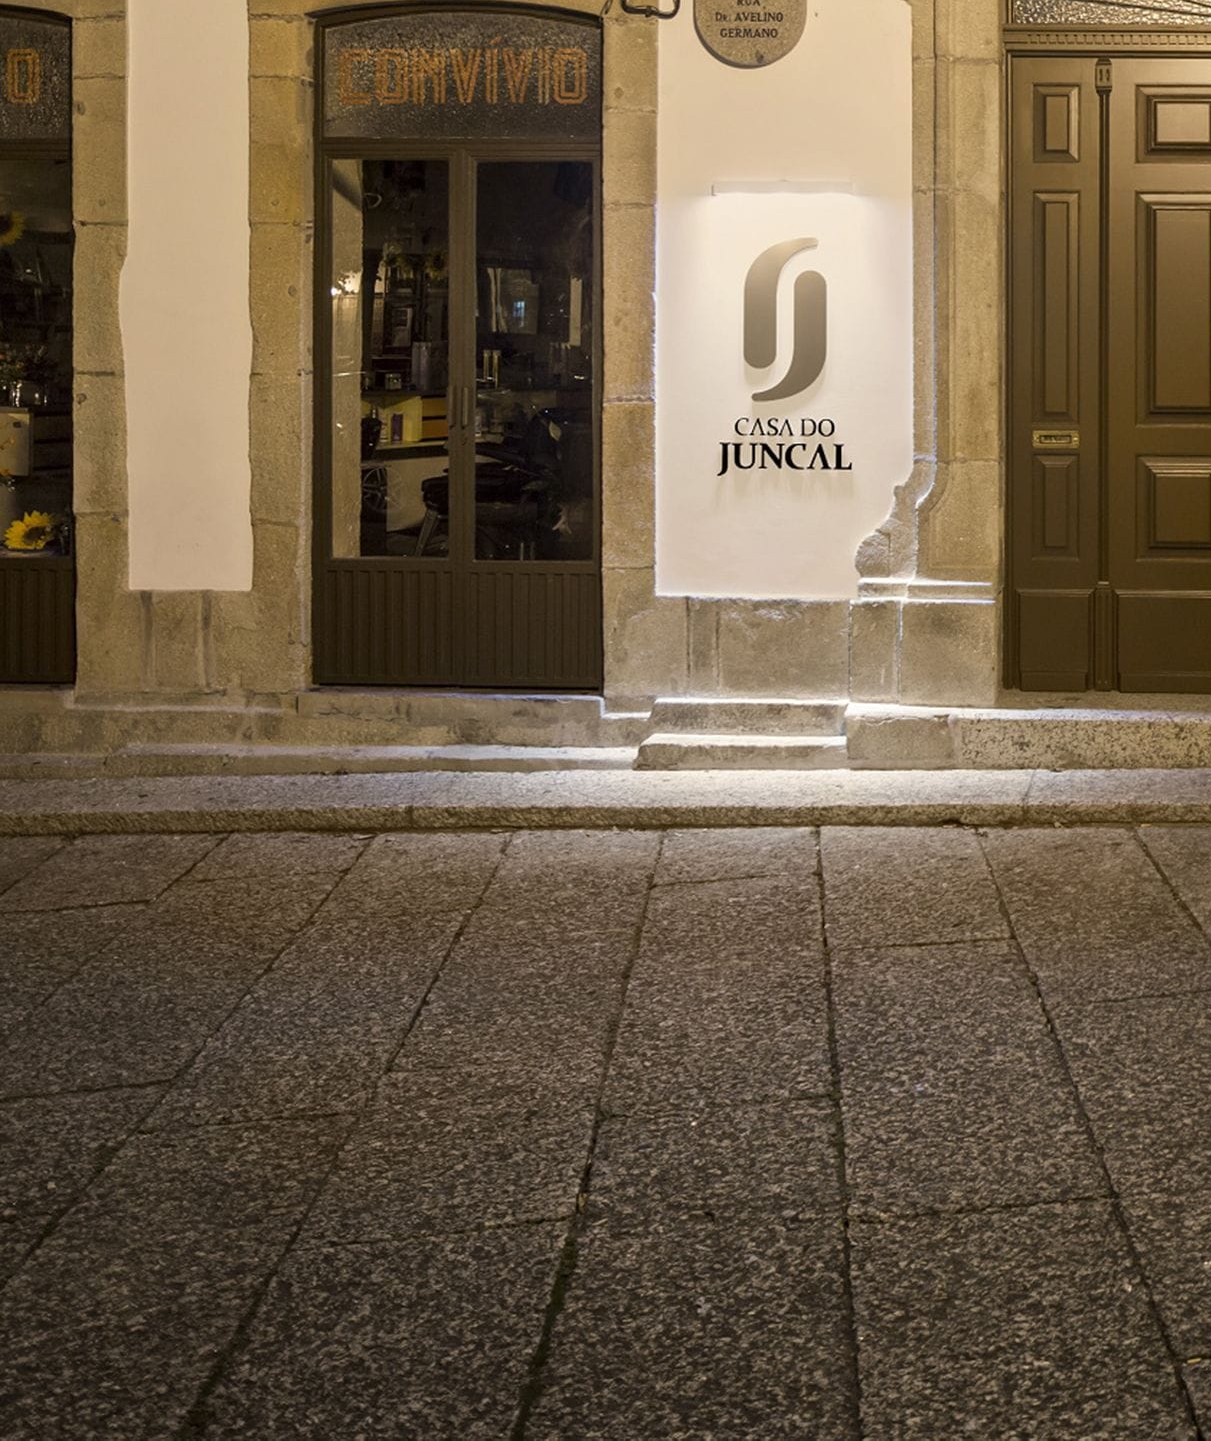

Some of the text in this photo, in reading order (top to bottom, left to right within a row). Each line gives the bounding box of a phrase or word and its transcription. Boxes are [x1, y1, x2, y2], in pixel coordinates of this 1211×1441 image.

[734, 12, 784, 21] AVELINO
[720, 28, 778, 39] GERMANO
[337, 35, 588, 106] CONVÍVIO
[734, 417, 836, 437] CASA DO
[716, 441, 853, 476] JUNCAL
